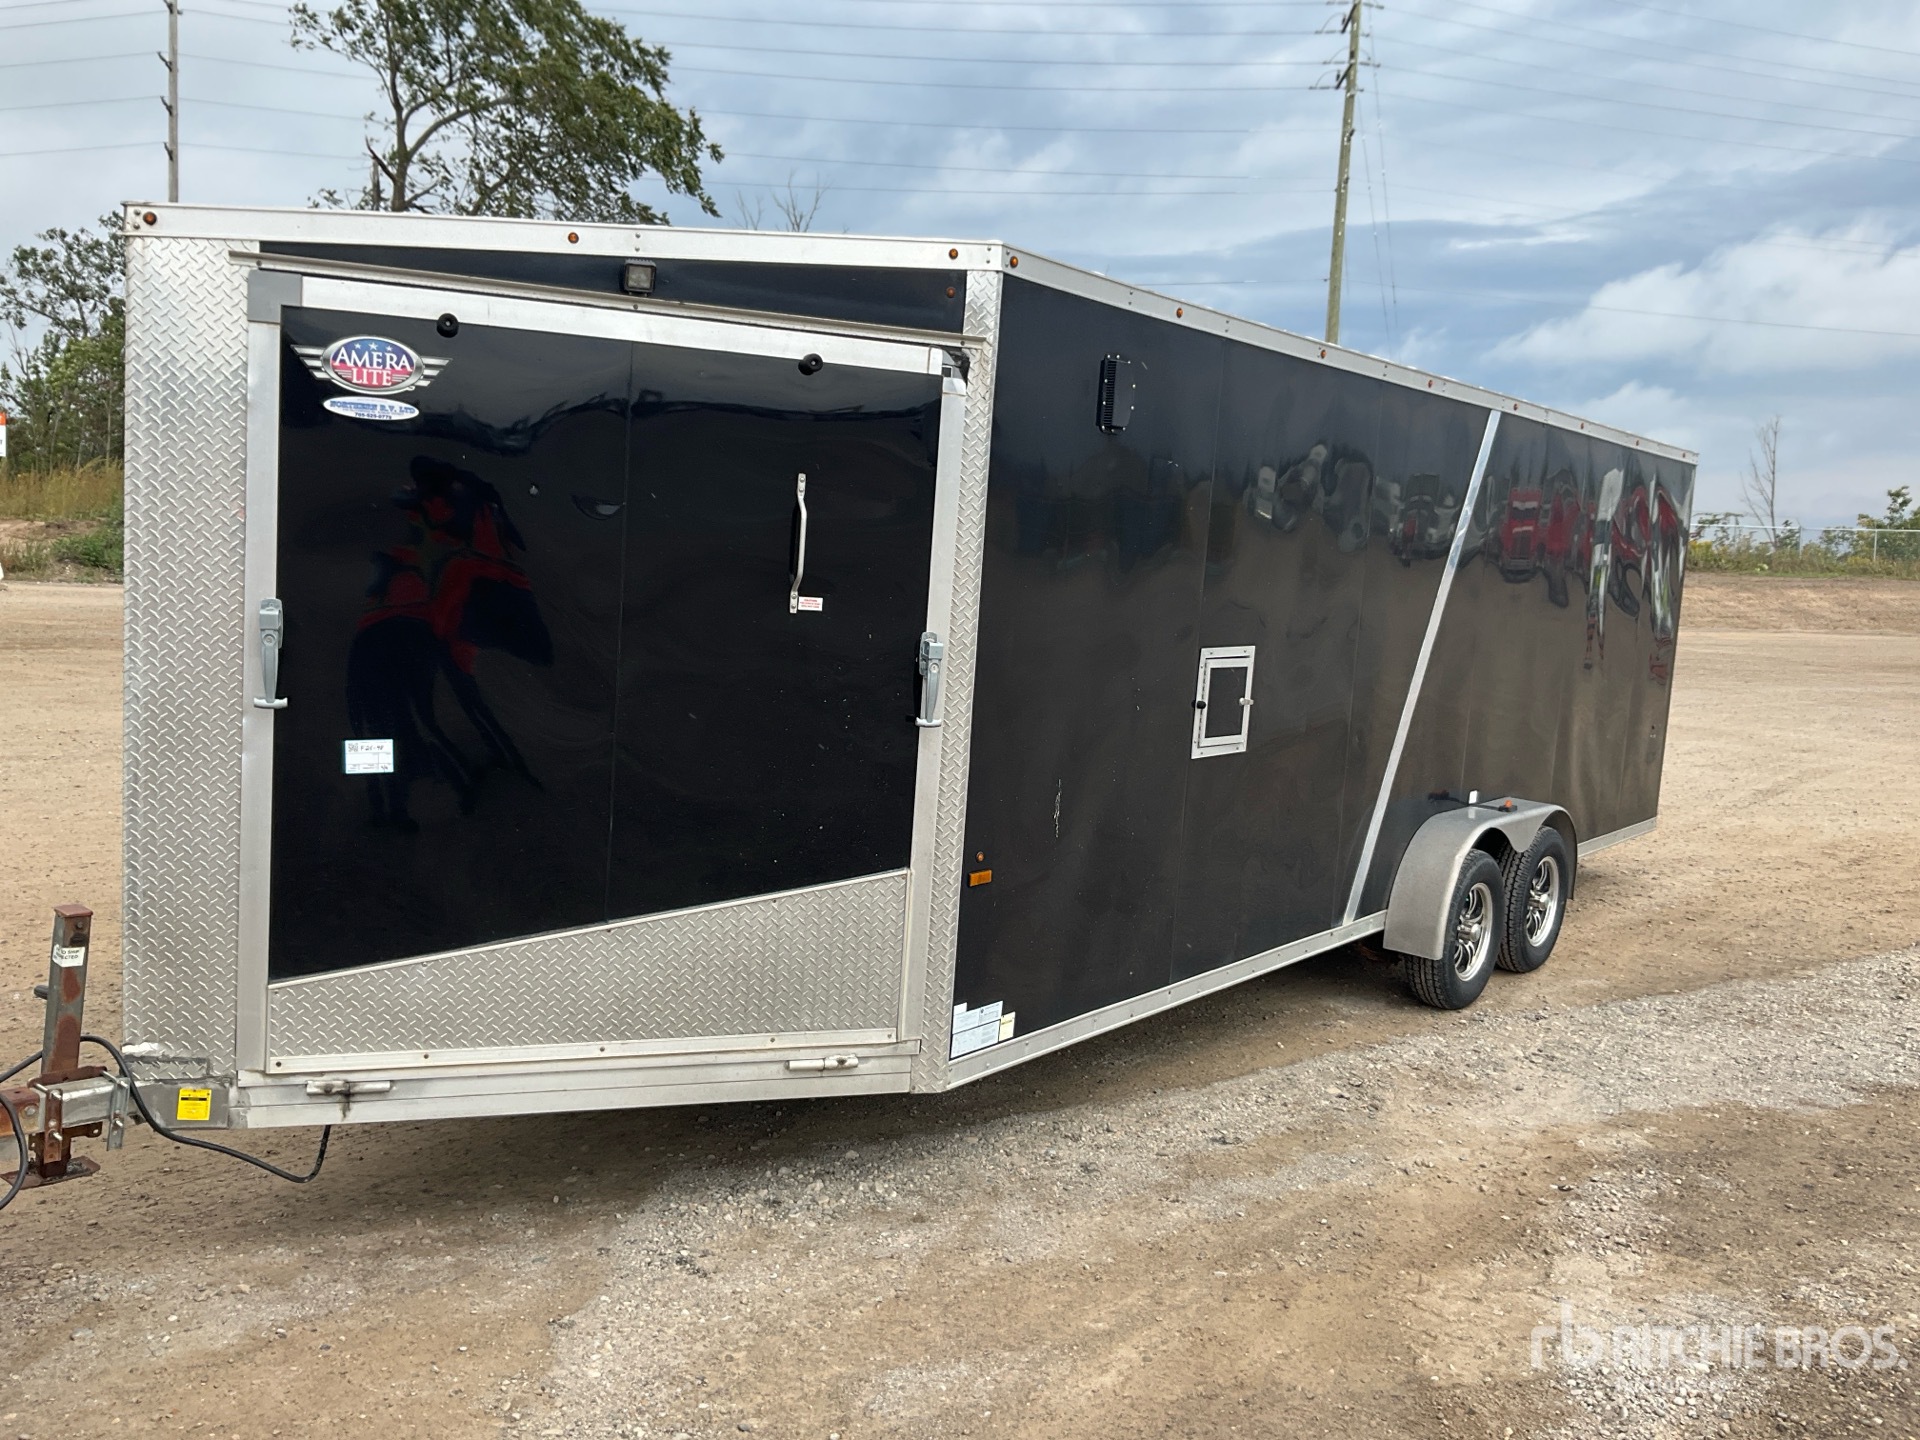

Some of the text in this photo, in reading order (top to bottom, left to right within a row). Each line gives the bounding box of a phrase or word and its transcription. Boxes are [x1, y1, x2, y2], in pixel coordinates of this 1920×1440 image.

[333, 347, 413, 371] AMERA
[351, 367, 392, 386] LITE
[330, 401, 377, 410] NORTHERN
[399, 406, 415, 414] LTD
